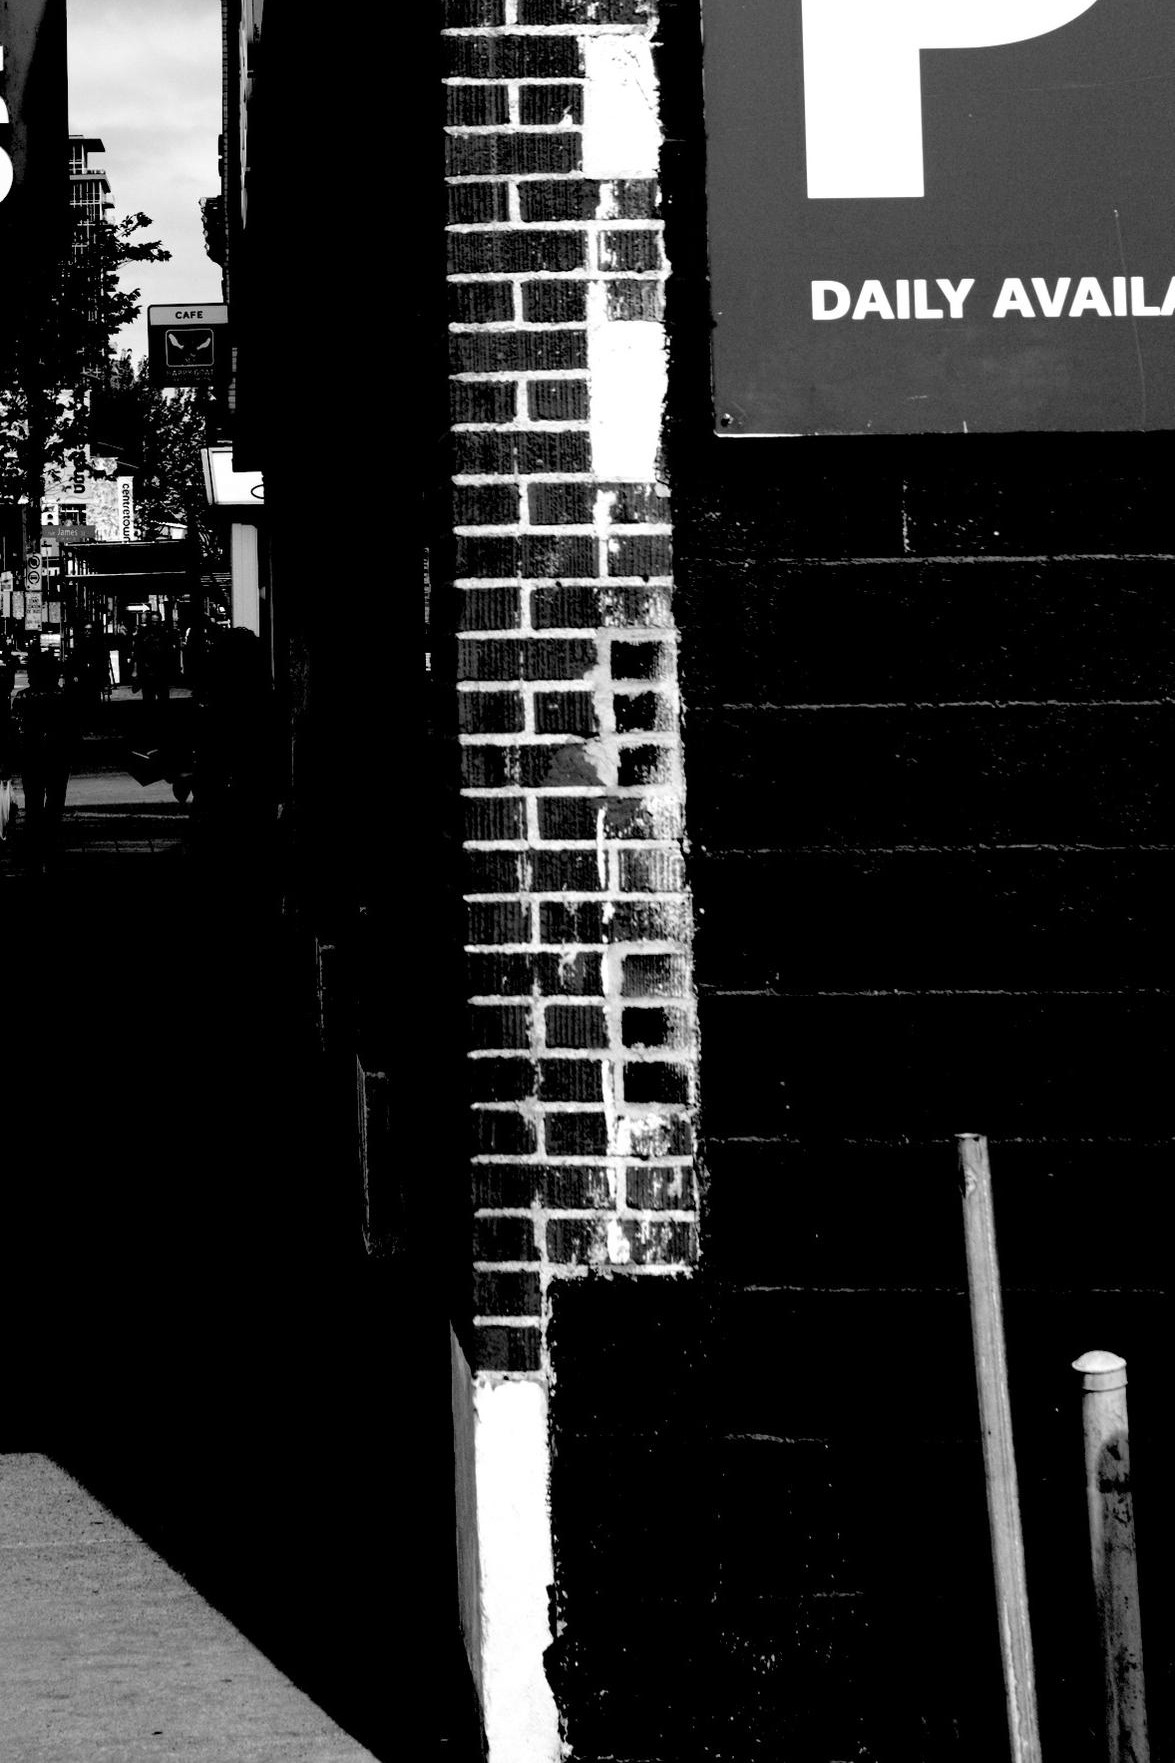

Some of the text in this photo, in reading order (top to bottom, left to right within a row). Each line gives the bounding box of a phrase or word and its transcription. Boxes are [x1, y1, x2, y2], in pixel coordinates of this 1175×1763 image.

[811, 279, 975, 321] DAILY
[175, 310, 204, 320] CAFE
[57, 527, 78, 536] James
